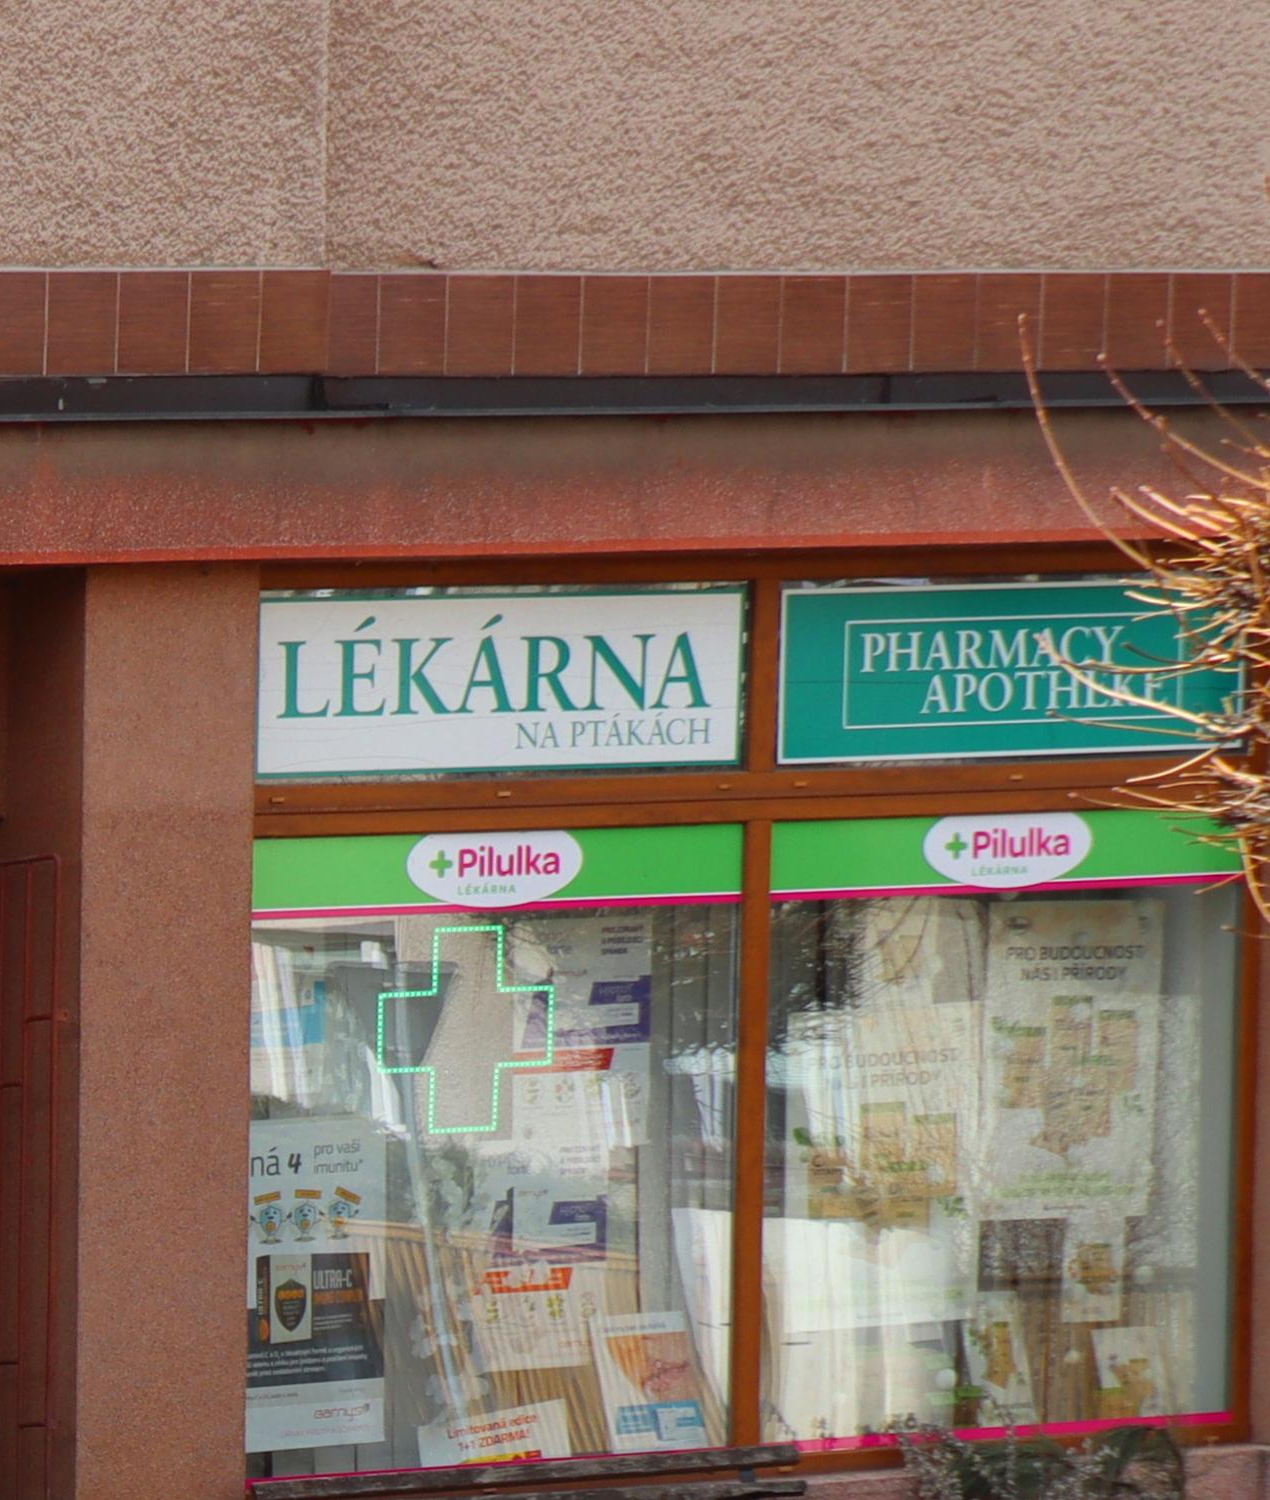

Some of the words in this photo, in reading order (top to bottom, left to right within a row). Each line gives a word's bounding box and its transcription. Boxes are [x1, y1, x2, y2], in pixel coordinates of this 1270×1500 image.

[860, 626, 1125, 672] PHARMACY
[276, 614, 711, 719] LÉKÁRNA
[516, 723, 560, 749] NA
[570, 713, 711, 748] PTÁKÁCH
[972, 827, 1071, 858] Pilulka
[458, 845, 560, 877] Pilulka
[971, 864, 1028, 877] LÉKÁRNA
[457, 882, 516, 896] LÉKÁRNA
[287, 1152, 302, 1175] 4
[314, 1144, 334, 1159] pro
[312, 1268, 353, 1289] ULTRA-C
